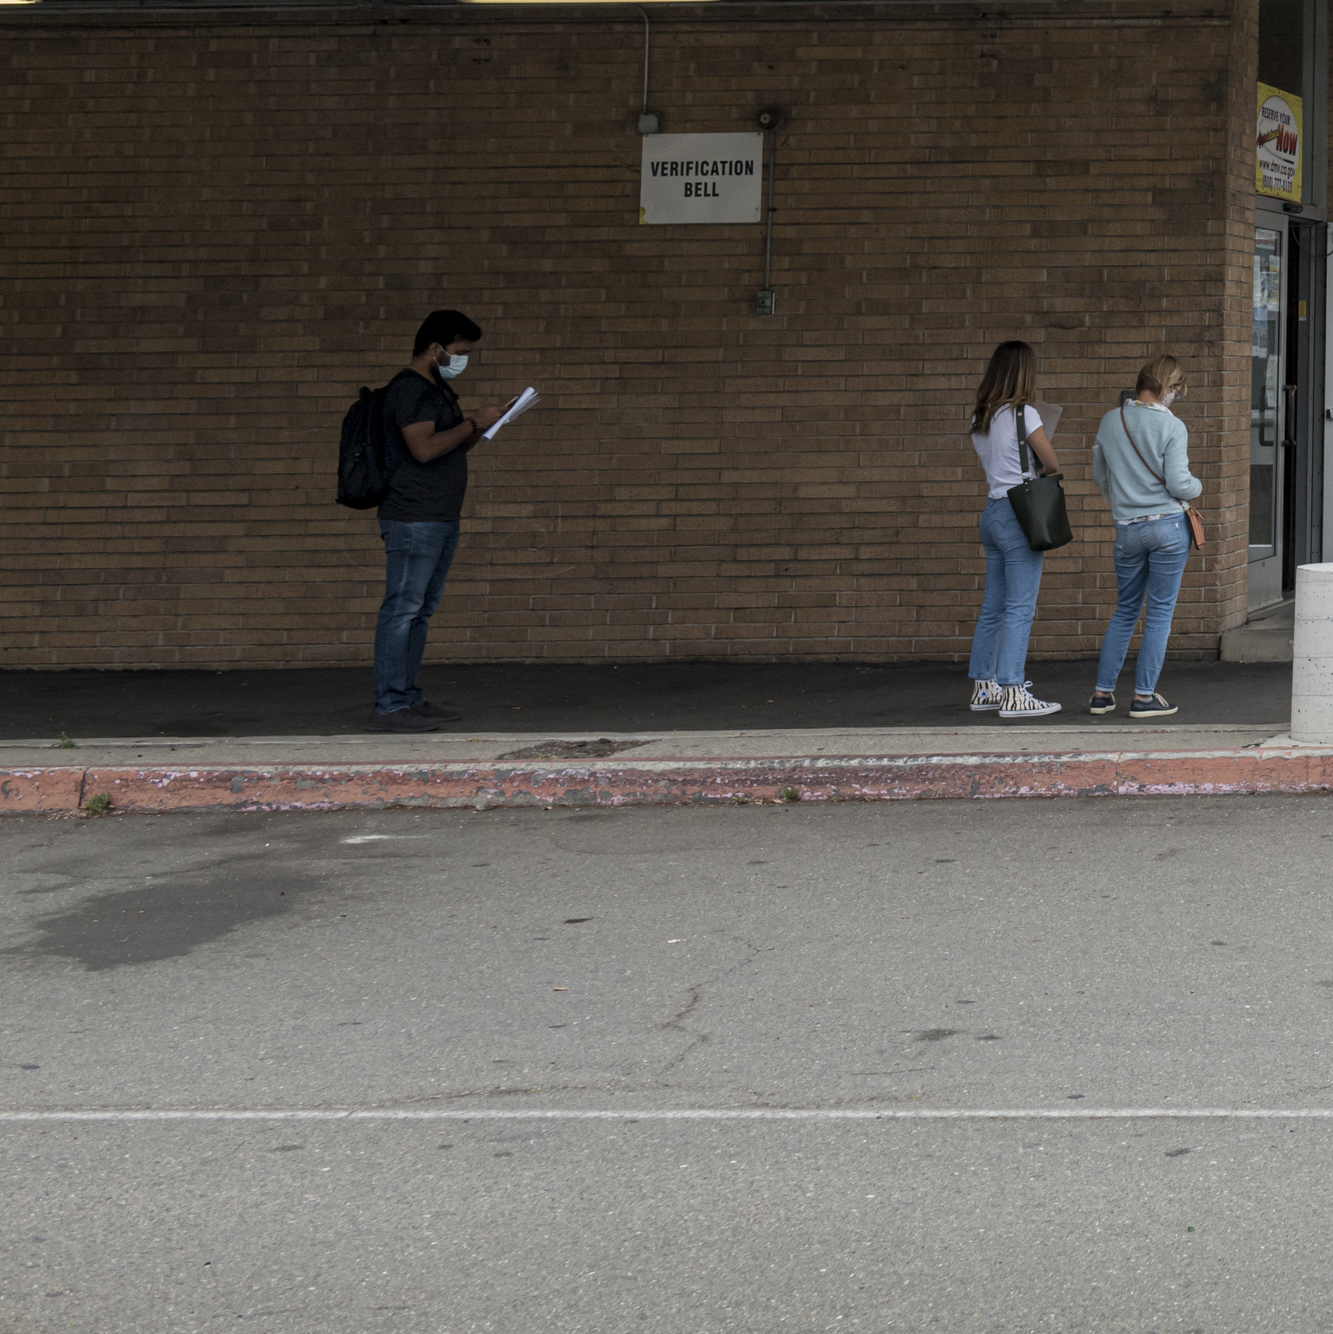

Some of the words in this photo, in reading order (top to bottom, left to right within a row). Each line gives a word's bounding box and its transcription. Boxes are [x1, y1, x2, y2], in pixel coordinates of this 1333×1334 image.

[1261, 106, 1279, 122] RESERVE
[1279, 112, 1291, 126] YOUR
[650, 159, 754, 177] VERIFICATION
[683, 181, 720, 198] BELL
